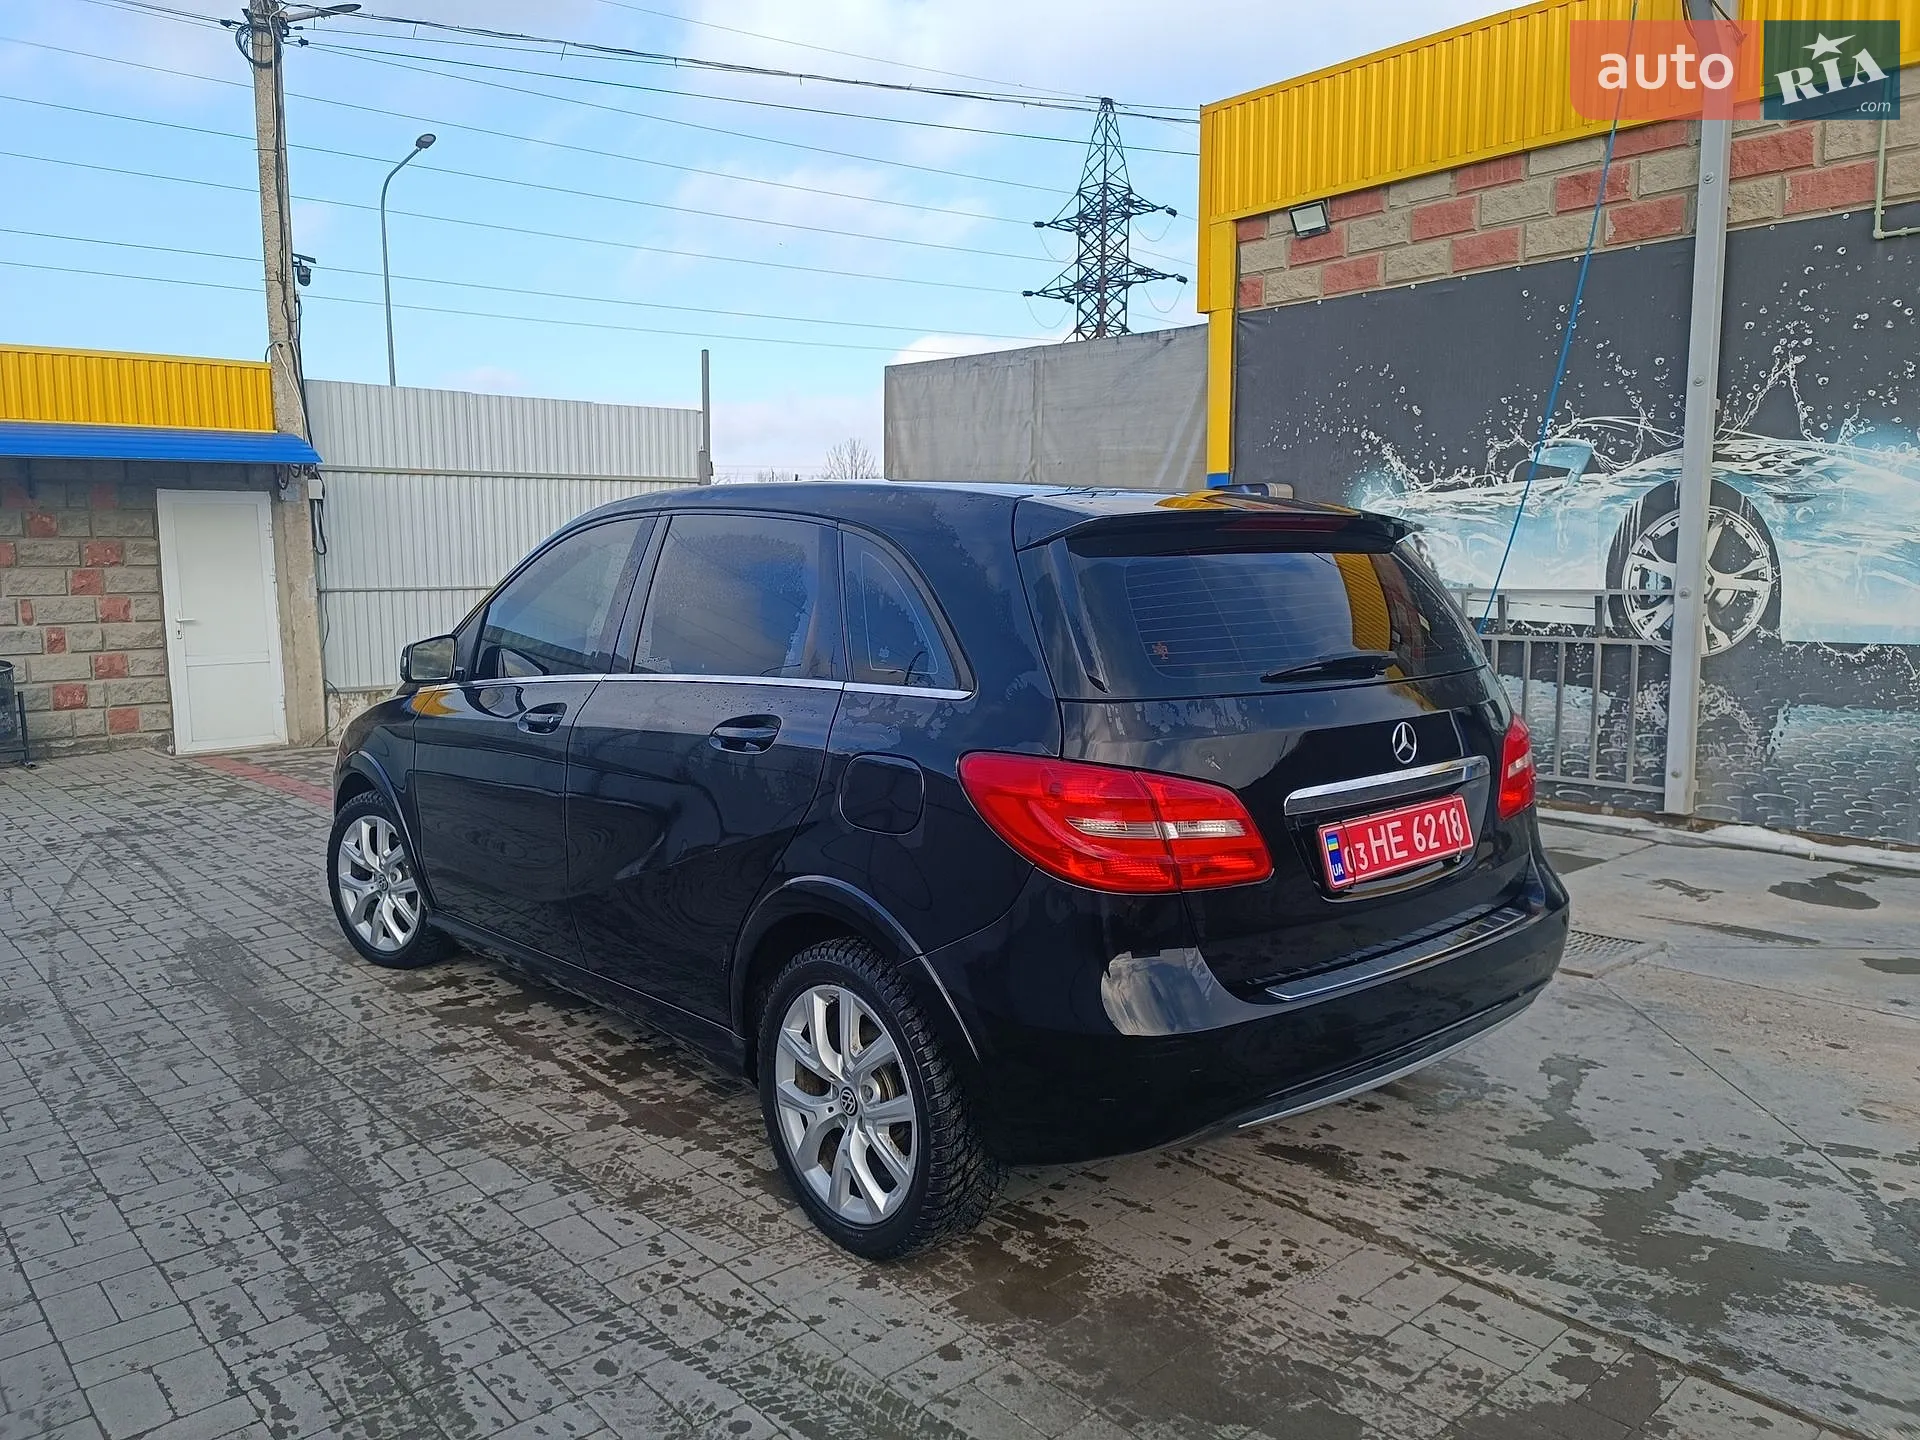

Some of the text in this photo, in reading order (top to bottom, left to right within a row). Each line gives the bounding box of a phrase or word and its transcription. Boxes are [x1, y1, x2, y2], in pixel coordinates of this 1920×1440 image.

[1368, 820, 1408, 865] HE
[1413, 807, 1464, 852] 6218
[1332, 865, 1344, 876] UA
